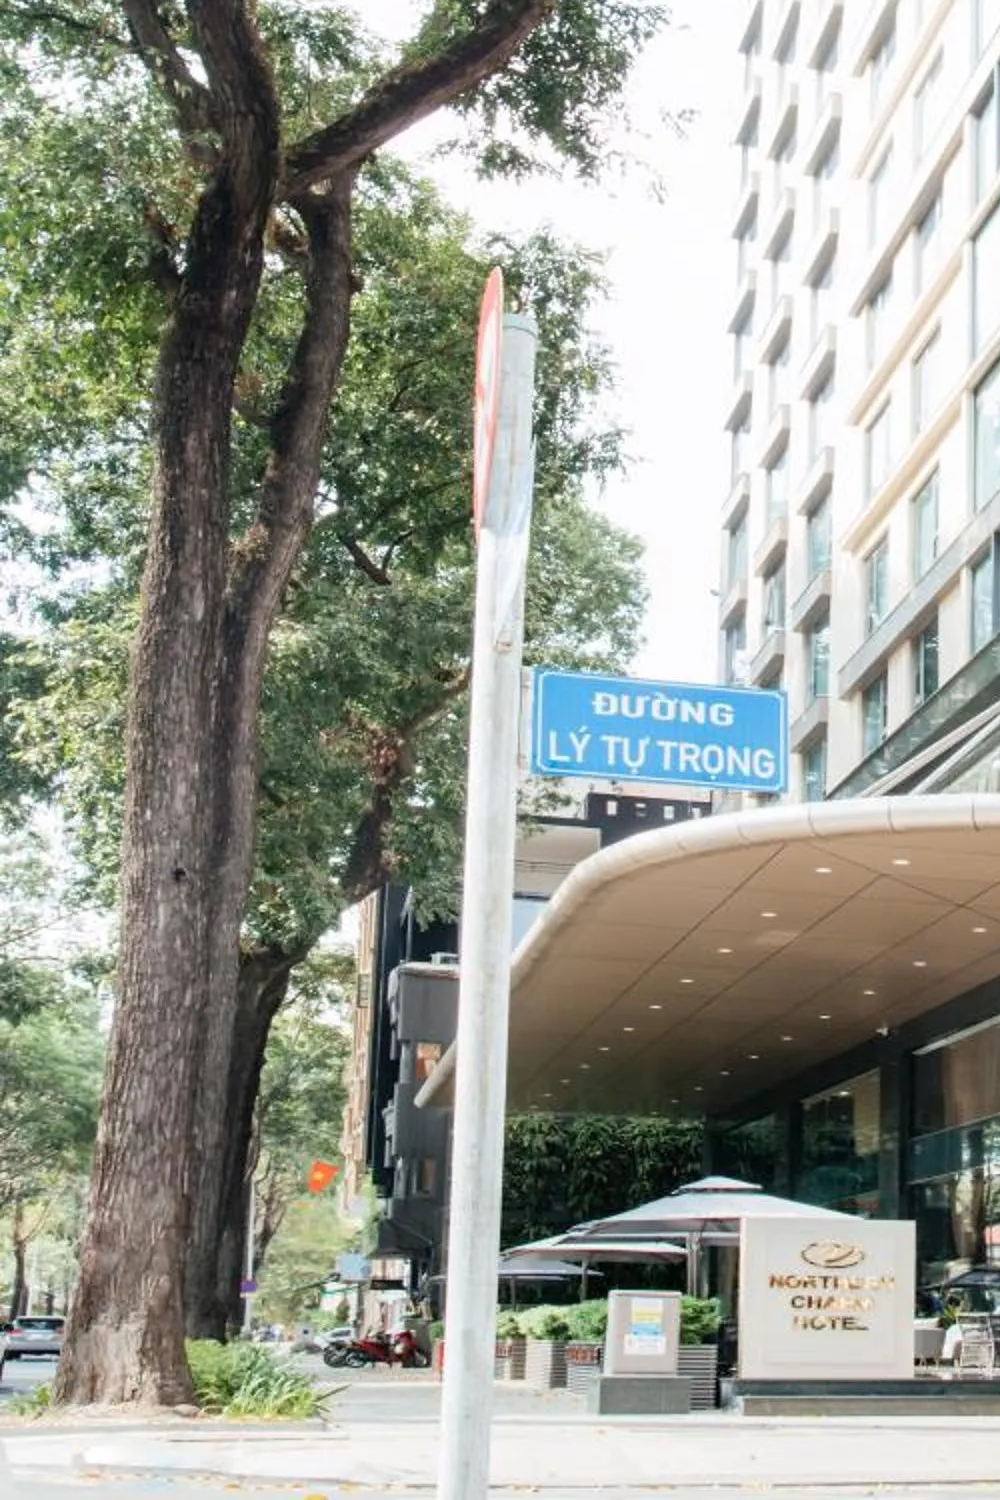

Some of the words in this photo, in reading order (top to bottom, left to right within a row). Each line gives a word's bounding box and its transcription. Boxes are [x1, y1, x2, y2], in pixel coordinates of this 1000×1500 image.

[592, 691, 735, 726] ĐƯỜNG
[548, 726, 591, 763] LÝ
[601, 735, 651, 775] TỰ
[656, 740, 777, 780] TRỌNG
